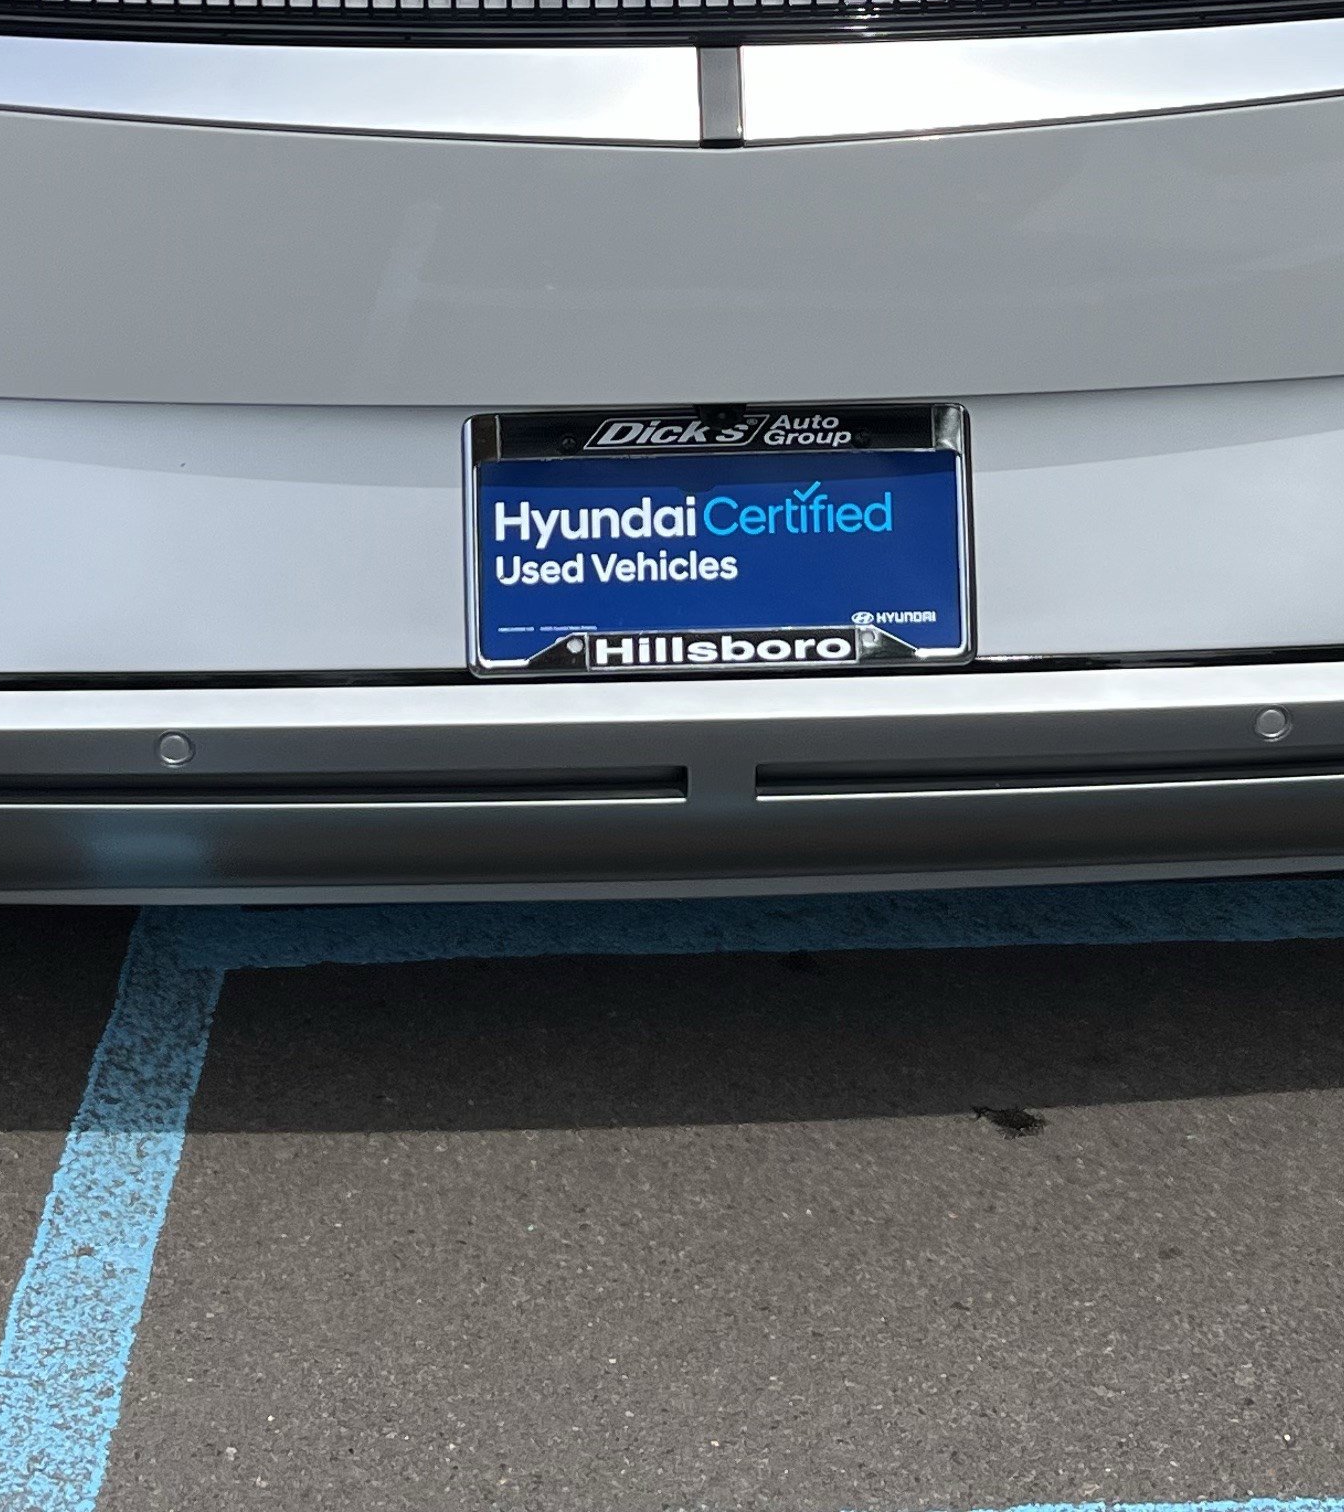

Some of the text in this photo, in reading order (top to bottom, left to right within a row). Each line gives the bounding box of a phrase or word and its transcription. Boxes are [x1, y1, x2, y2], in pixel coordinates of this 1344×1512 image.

[596, 420, 749, 445] Dicks
[770, 414, 840, 430] Auto
[763, 430, 853, 447] Group
[494, 483, 893, 549] Hyundai Certified
[494, 550, 739, 586] Used Vehicles
[875, 610, 937, 624] HYUNDAI
[594, 635, 852, 666] Hillsboro
